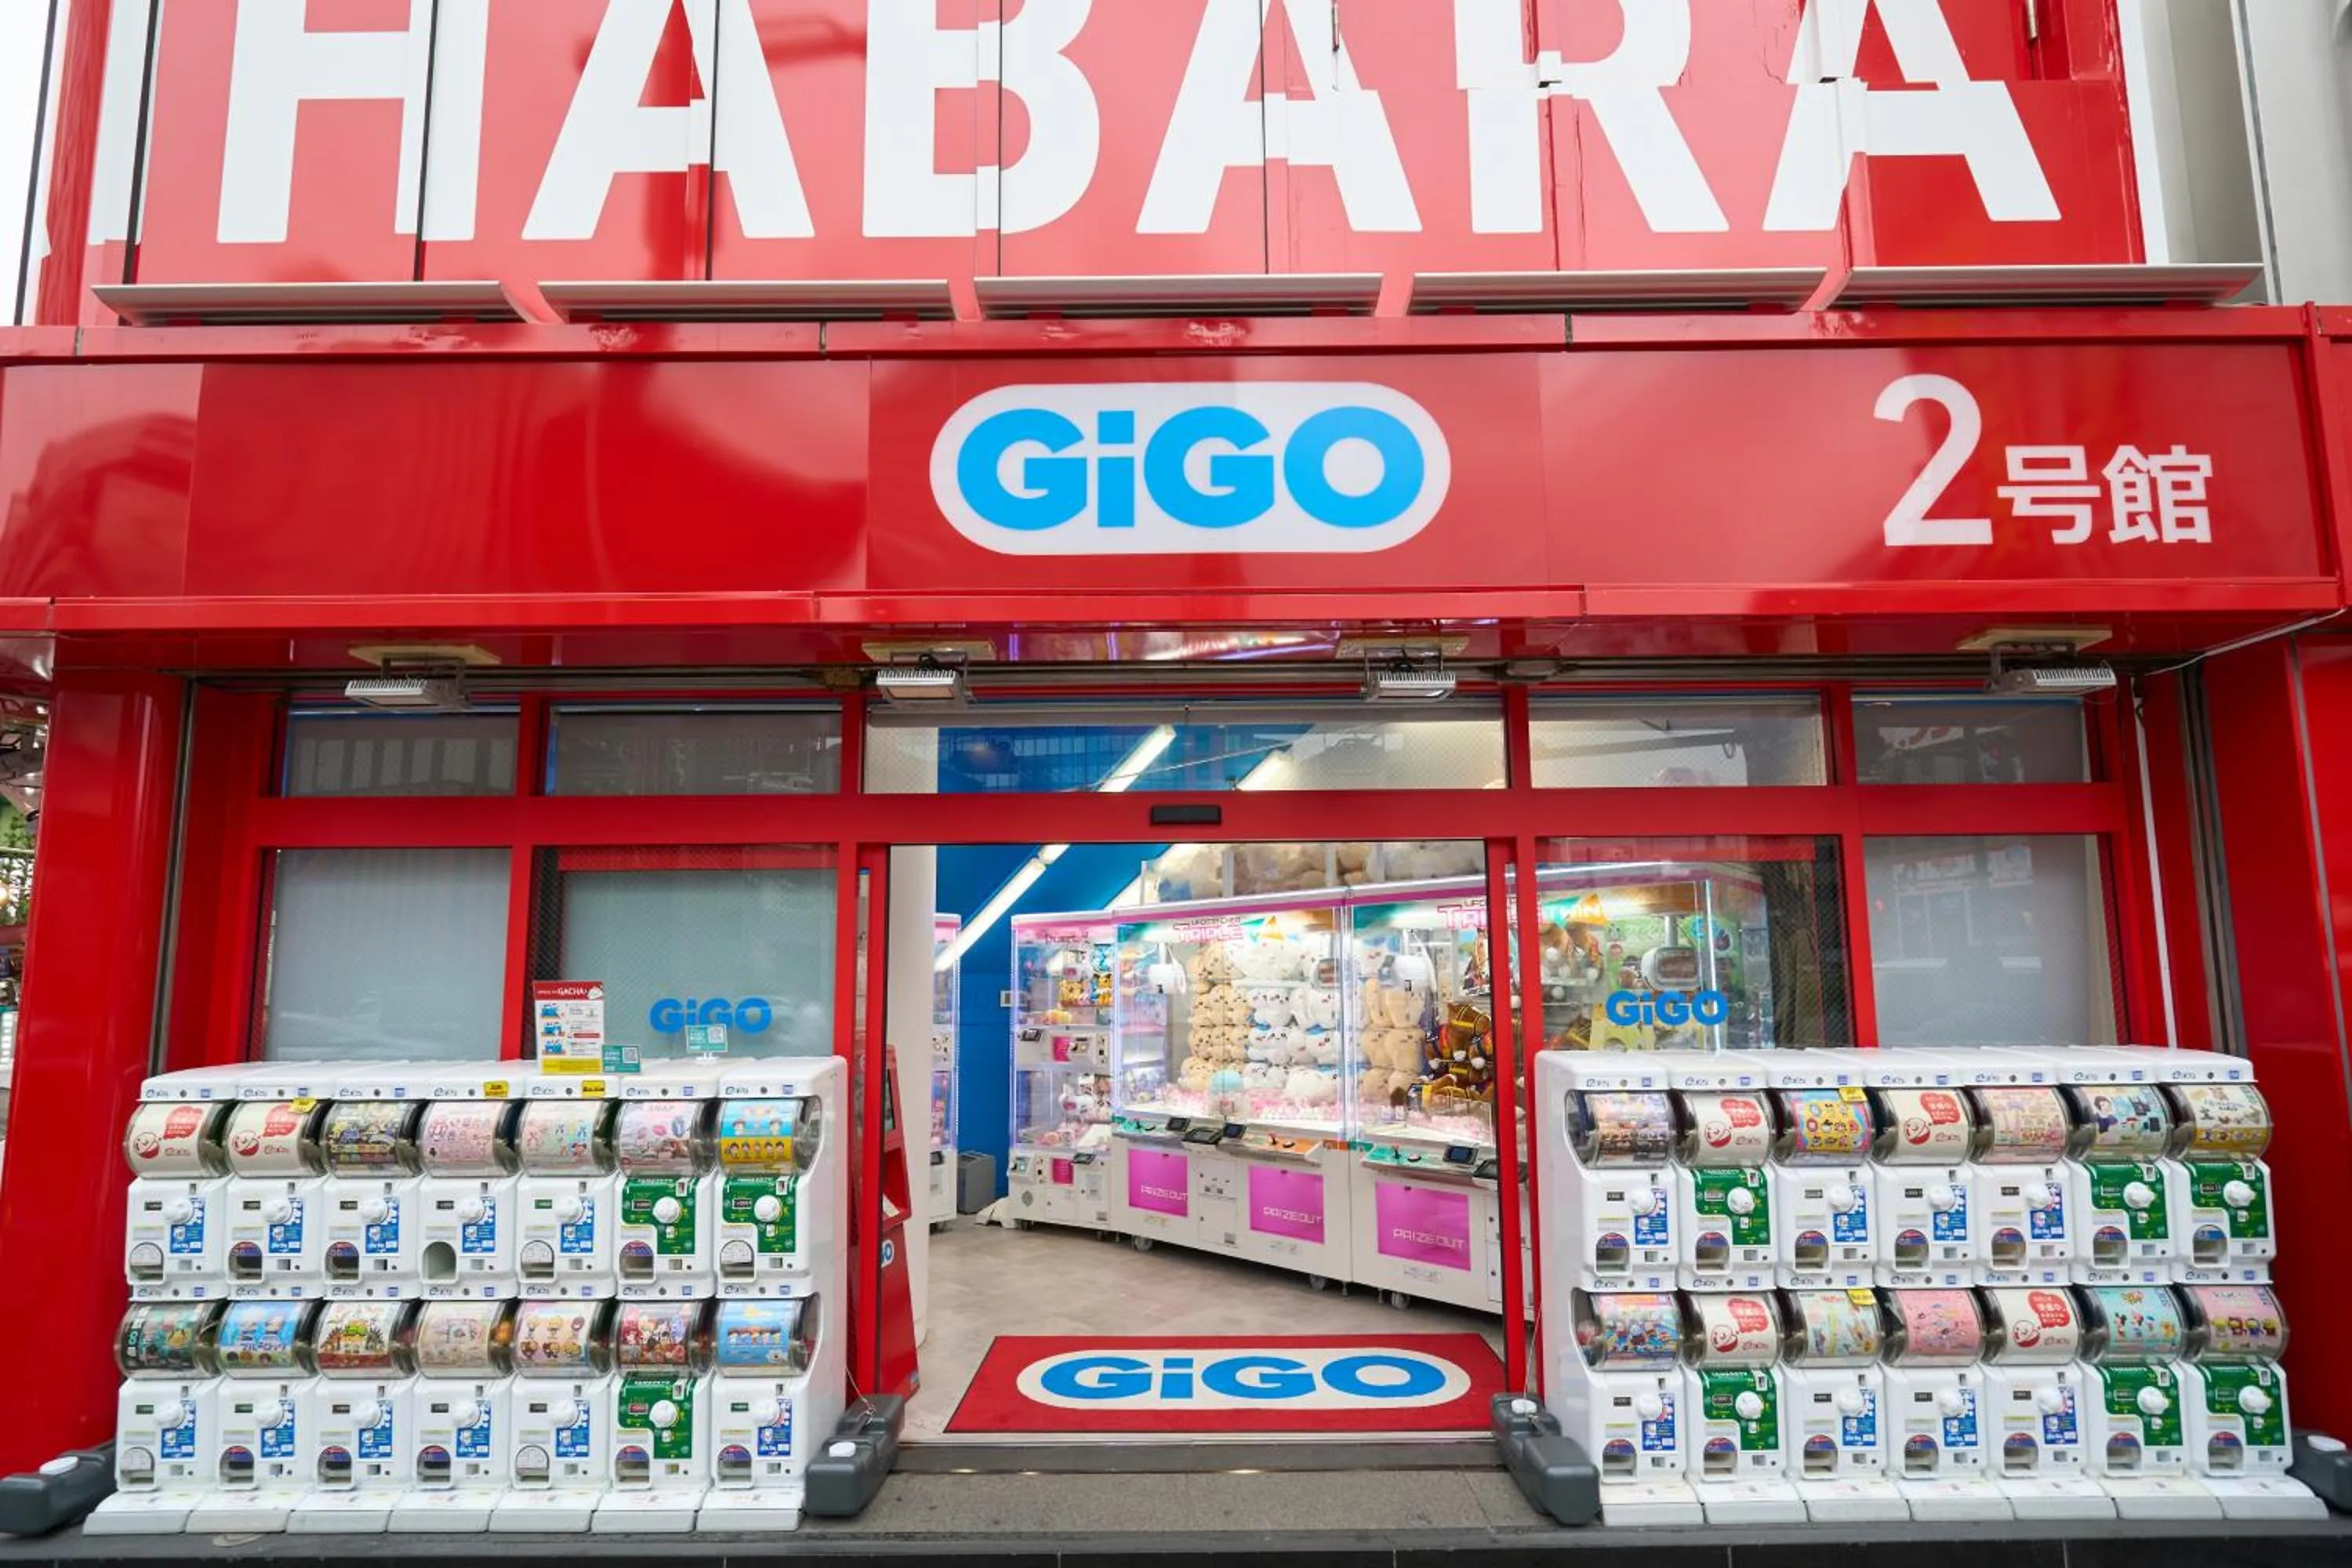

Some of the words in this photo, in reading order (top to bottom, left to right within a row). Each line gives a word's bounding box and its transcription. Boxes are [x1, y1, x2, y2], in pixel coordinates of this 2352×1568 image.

[957, 405, 1425, 531] GiGO
[1872, 373, 2213, 547] 2号館
[650, 996, 773, 1034] GiGO
[1606, 989, 1729, 1026] GiGO
[1041, 1355, 1446, 1400] GiGO
